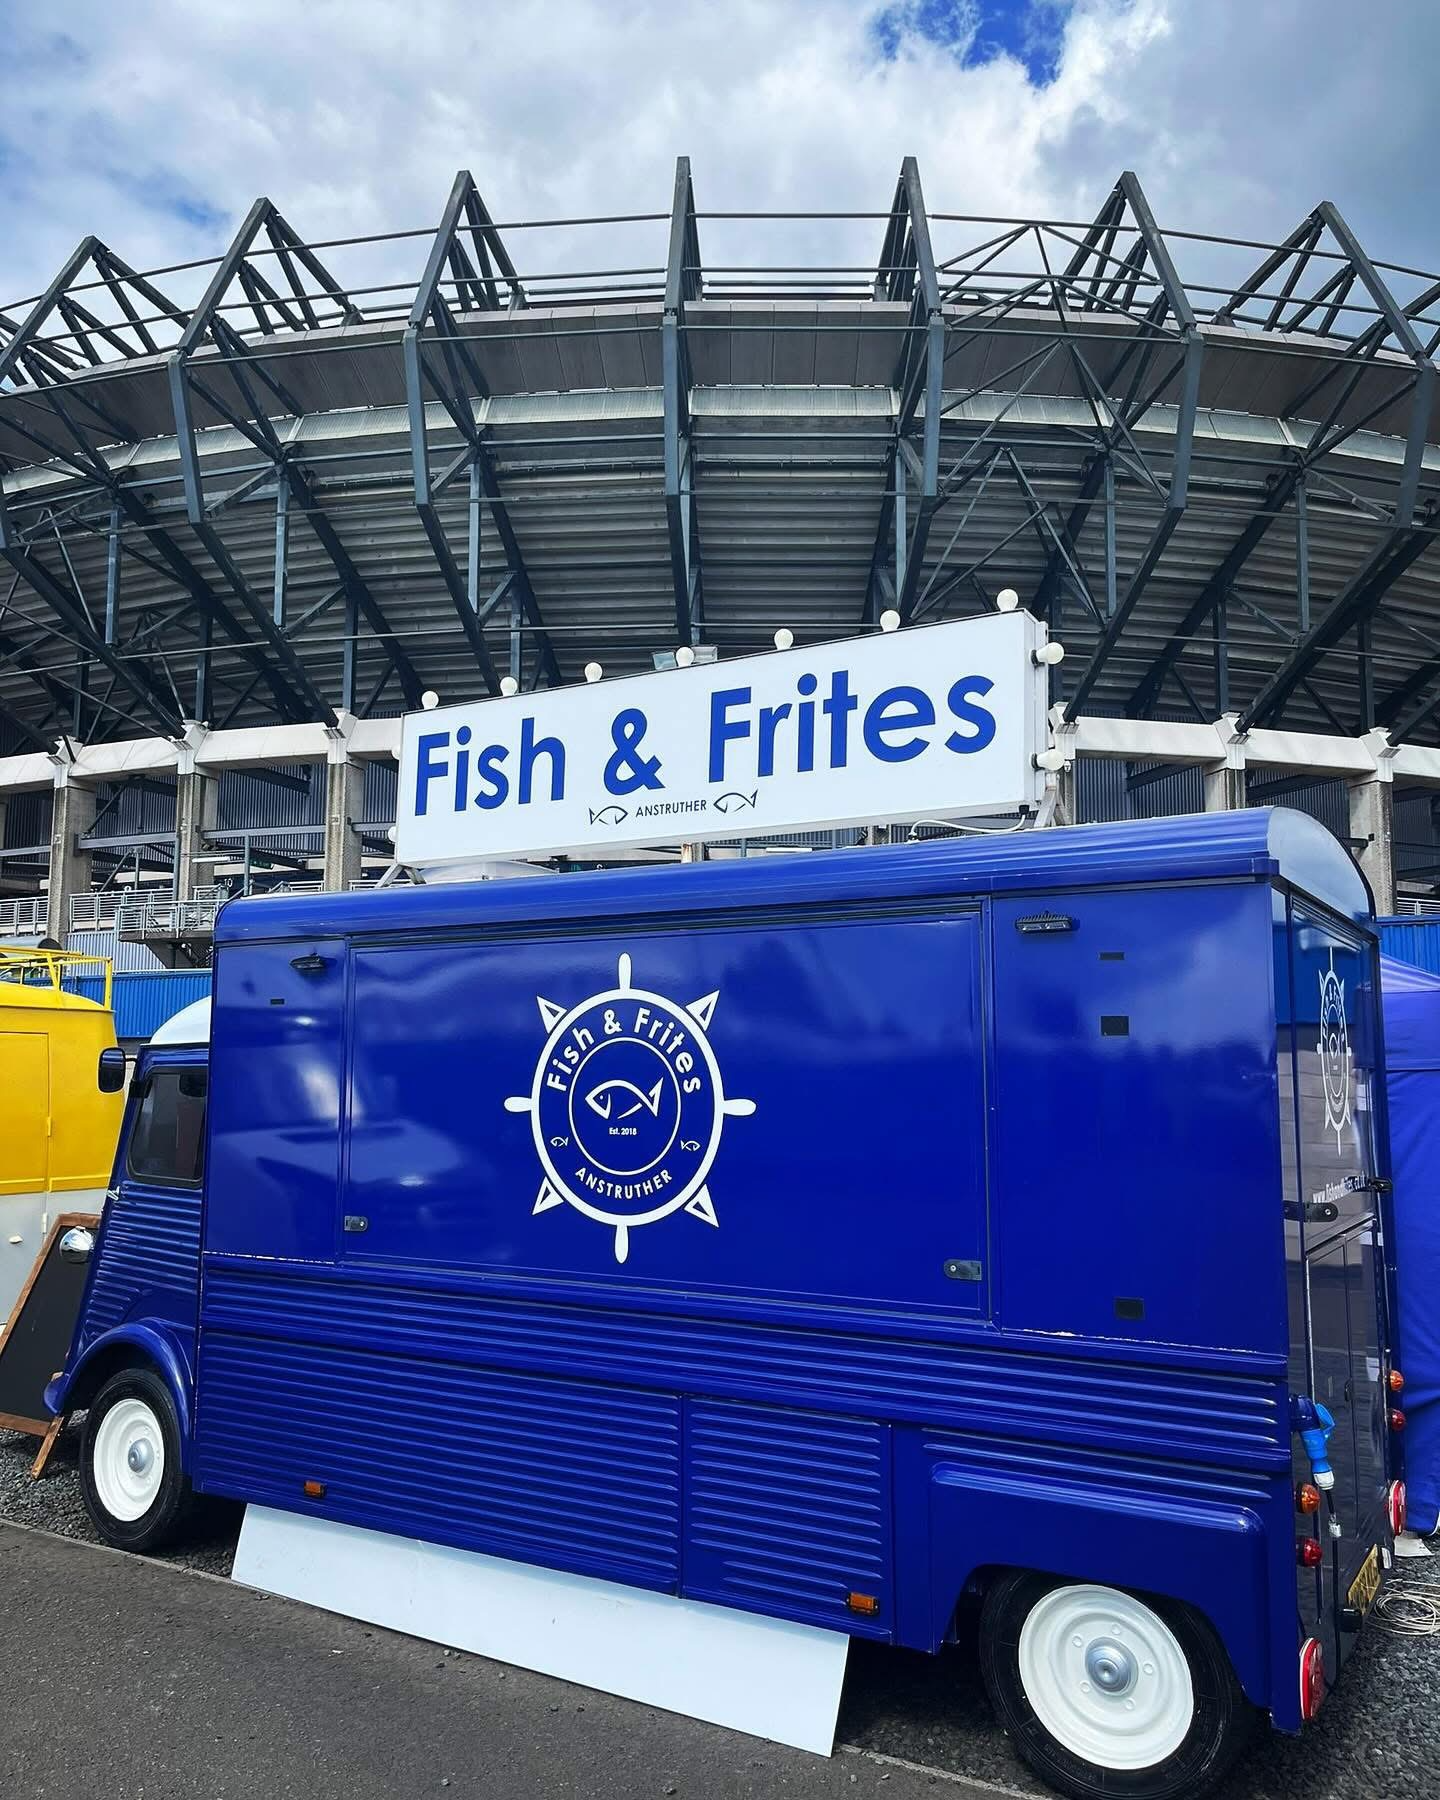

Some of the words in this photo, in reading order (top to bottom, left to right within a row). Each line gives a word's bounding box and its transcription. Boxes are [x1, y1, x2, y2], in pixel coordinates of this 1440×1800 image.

[415, 717, 566, 817] Fish
[603, 708, 664, 796] &
[708, 670, 997, 782] Frites
[635, 799, 707, 818] ANSTRUTHER
[546, 1027, 594, 1092] Fish
[603, 1009, 622, 1035] &
[633, 1007, 701, 1094] Frites
[608, 1127, 621, 1136] Est.
[620, 1127, 637, 1136] 2018
[575, 1167, 673, 1200] ANSTRUTHER
